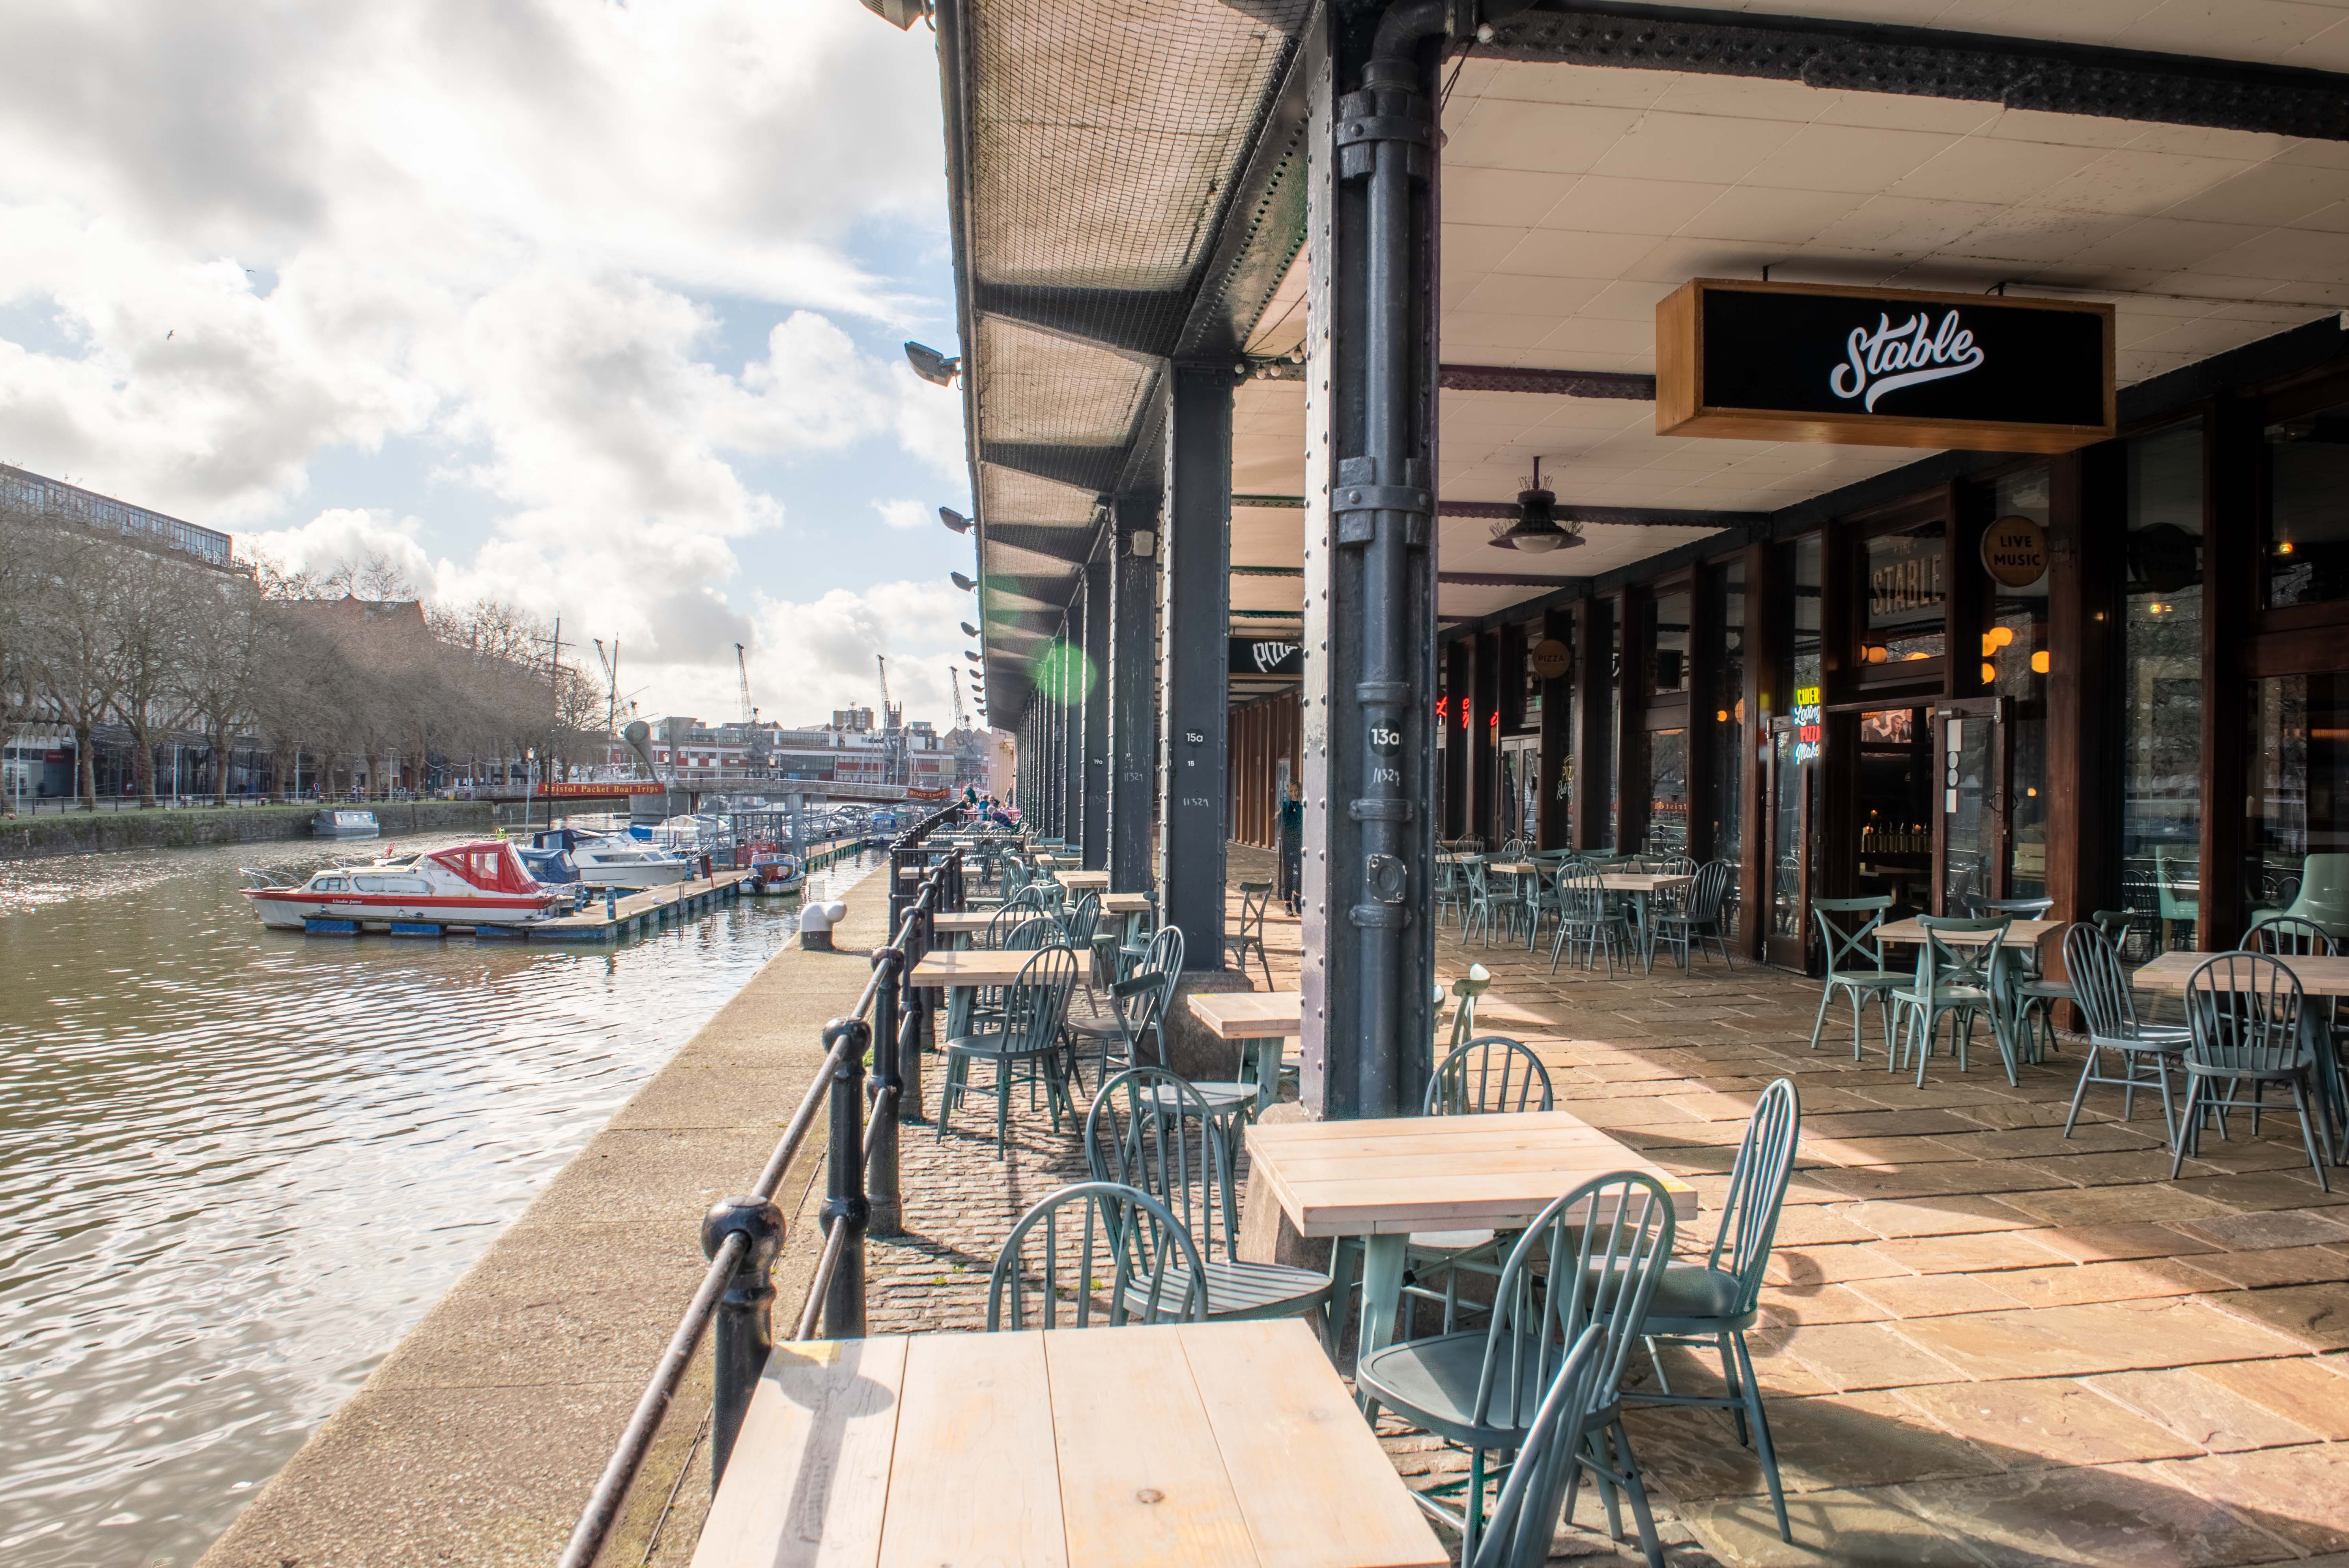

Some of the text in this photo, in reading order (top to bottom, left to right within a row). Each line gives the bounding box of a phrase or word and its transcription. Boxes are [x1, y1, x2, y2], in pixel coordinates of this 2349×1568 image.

[1830, 309, 1984, 413] Stable
[2000, 536, 2032, 548] LIVE
[197, 546, 212, 563] The
[1994, 554, 2040, 566] MUSIC
[1872, 554, 1941, 615] STABLE
[1253, 642, 1299, 673] PIZZA
[1797, 687, 1820, 705] CIDER
[1186, 733, 1203, 742] 15a
[1371, 729, 1399, 745] 13a
